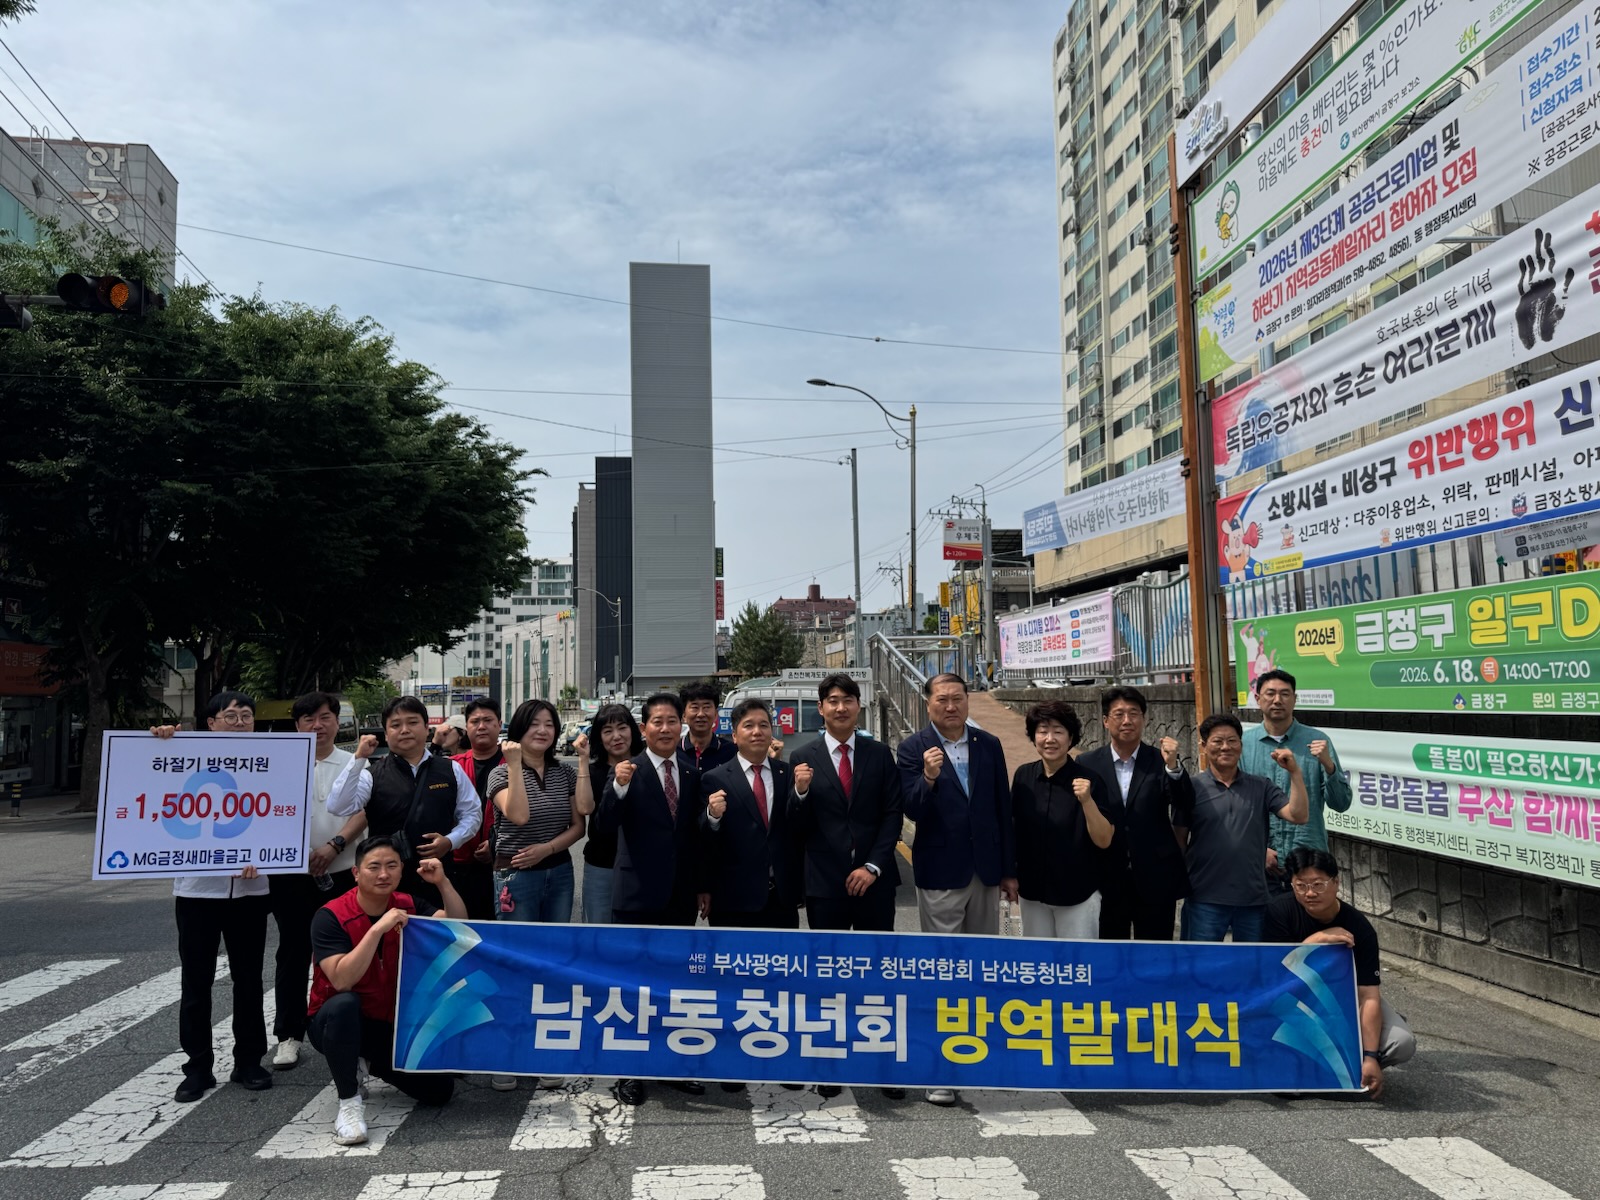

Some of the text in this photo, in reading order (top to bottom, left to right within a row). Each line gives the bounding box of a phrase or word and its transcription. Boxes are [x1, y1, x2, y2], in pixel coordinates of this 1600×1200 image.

[1526, 22, 1580, 76] 접수기간
[1257, 133, 1286, 173] 당신의
[1289, 113, 1310, 143] 마음
[1312, 69, 1359, 120] 배터리는
[1362, 49, 1376, 78] 몇
[1379, 0, 1443, 60] %인가요
[1528, 52, 1582, 101] 접수장소
[1530, 75, 1583, 126] 신청자격
[1258, 54, 1400, 193] 마음에도 충전이 필요합니다
[1352, 76, 1421, 139] 부산광역시 금정구 보건소
[1258, 243, 1298, 288] 2026년
[1300, 203, 1346, 260] 제3단계
[1348, 134, 1438, 225] 공공근로사업
[1441, 118, 1461, 159] 및
[1252, 147, 1478, 323] 하반기 지역공동체일자리 참여자 모집
[1265, 319, 1283, 337] 금정구
[1290, 308, 1303, 322] 문의
[1414, 227, 1424, 243] 동
[1424, 193, 1477, 238] 행정복지센터
[1376, 268, 1493, 345] 호국보훈의 달 기념
[1225, 382, 1329, 453] 독립유공자와
[1332, 362, 1377, 406] 후손
[1382, 300, 1497, 384] 여러분께
[1407, 399, 1537, 480] 위반행위
[1553, 375, 1600, 436] 신
[1298, 516, 1340, 543] 신고대상
[1353, 493, 1435, 527] 다중이용업소,
[1442, 480, 1478, 504] 위락,
[1485, 457, 1564, 496] 판매시설,
[1394, 519, 1437, 542] 위반행위
[1442, 507, 1490, 532] 신고문의
[956, 532, 980, 541] 우체국
[1028, 618, 1043, 636] 디지털
[1044, 614, 1061, 633] 오피스
[1298, 626, 1336, 647] 2026년
[1355, 603, 1455, 653] 금정구
[1400, 667, 1430, 683] 2026.
[1483, 661, 1496, 679] 목
[1502, 660, 1591, 680] 14:00-17:00
[1471, 692, 1600, 709] 금정구 문의 금정구
[152, 756, 269, 773] 하절기 방역지원
[1428, 746, 1600, 785] 돌봄이 필요하신가
[115, 807, 129, 819] 금
[1358, 771, 1449, 818] 통합돌봄
[1457, 783, 1514, 828] 부산
[133, 847, 298, 866] MG금정새마을금고 이사장
[1327, 811, 1362, 830] 신청문의:
[1364, 818, 1391, 838] 주소지
[1393, 823, 1404, 840] 동
[1405, 825, 1473, 856] 행정복지센터,
[1475, 839, 1512, 862] 금정구
[1516, 846, 1586, 876] 복지정책과
[688, 952, 706, 964] 사단
[688, 964, 706, 974] 법인
[712, 952, 1092, 987] 부산광역시 금정구 청년연합회 남산동청년회
[530, 983, 1241, 1067] 남산동청년회 방역발대식
